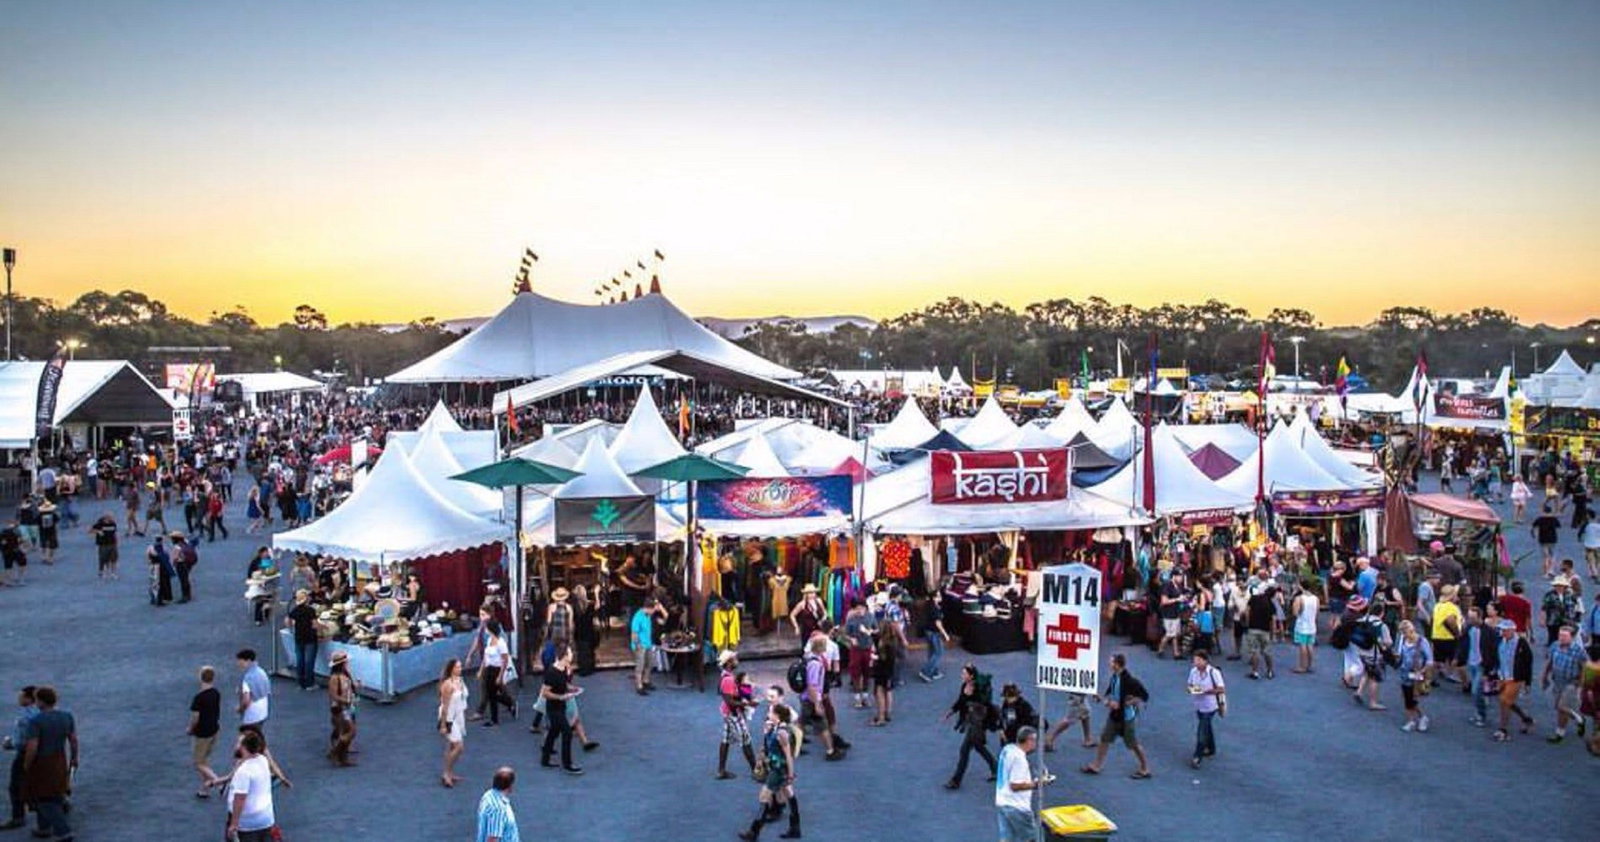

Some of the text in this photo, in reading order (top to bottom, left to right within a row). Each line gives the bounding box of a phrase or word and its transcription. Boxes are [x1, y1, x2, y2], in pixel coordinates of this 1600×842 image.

[951, 451, 1050, 501] kashi
[1042, 573, 1099, 607] M14
[1048, 629, 1091, 645] FIRST AID
